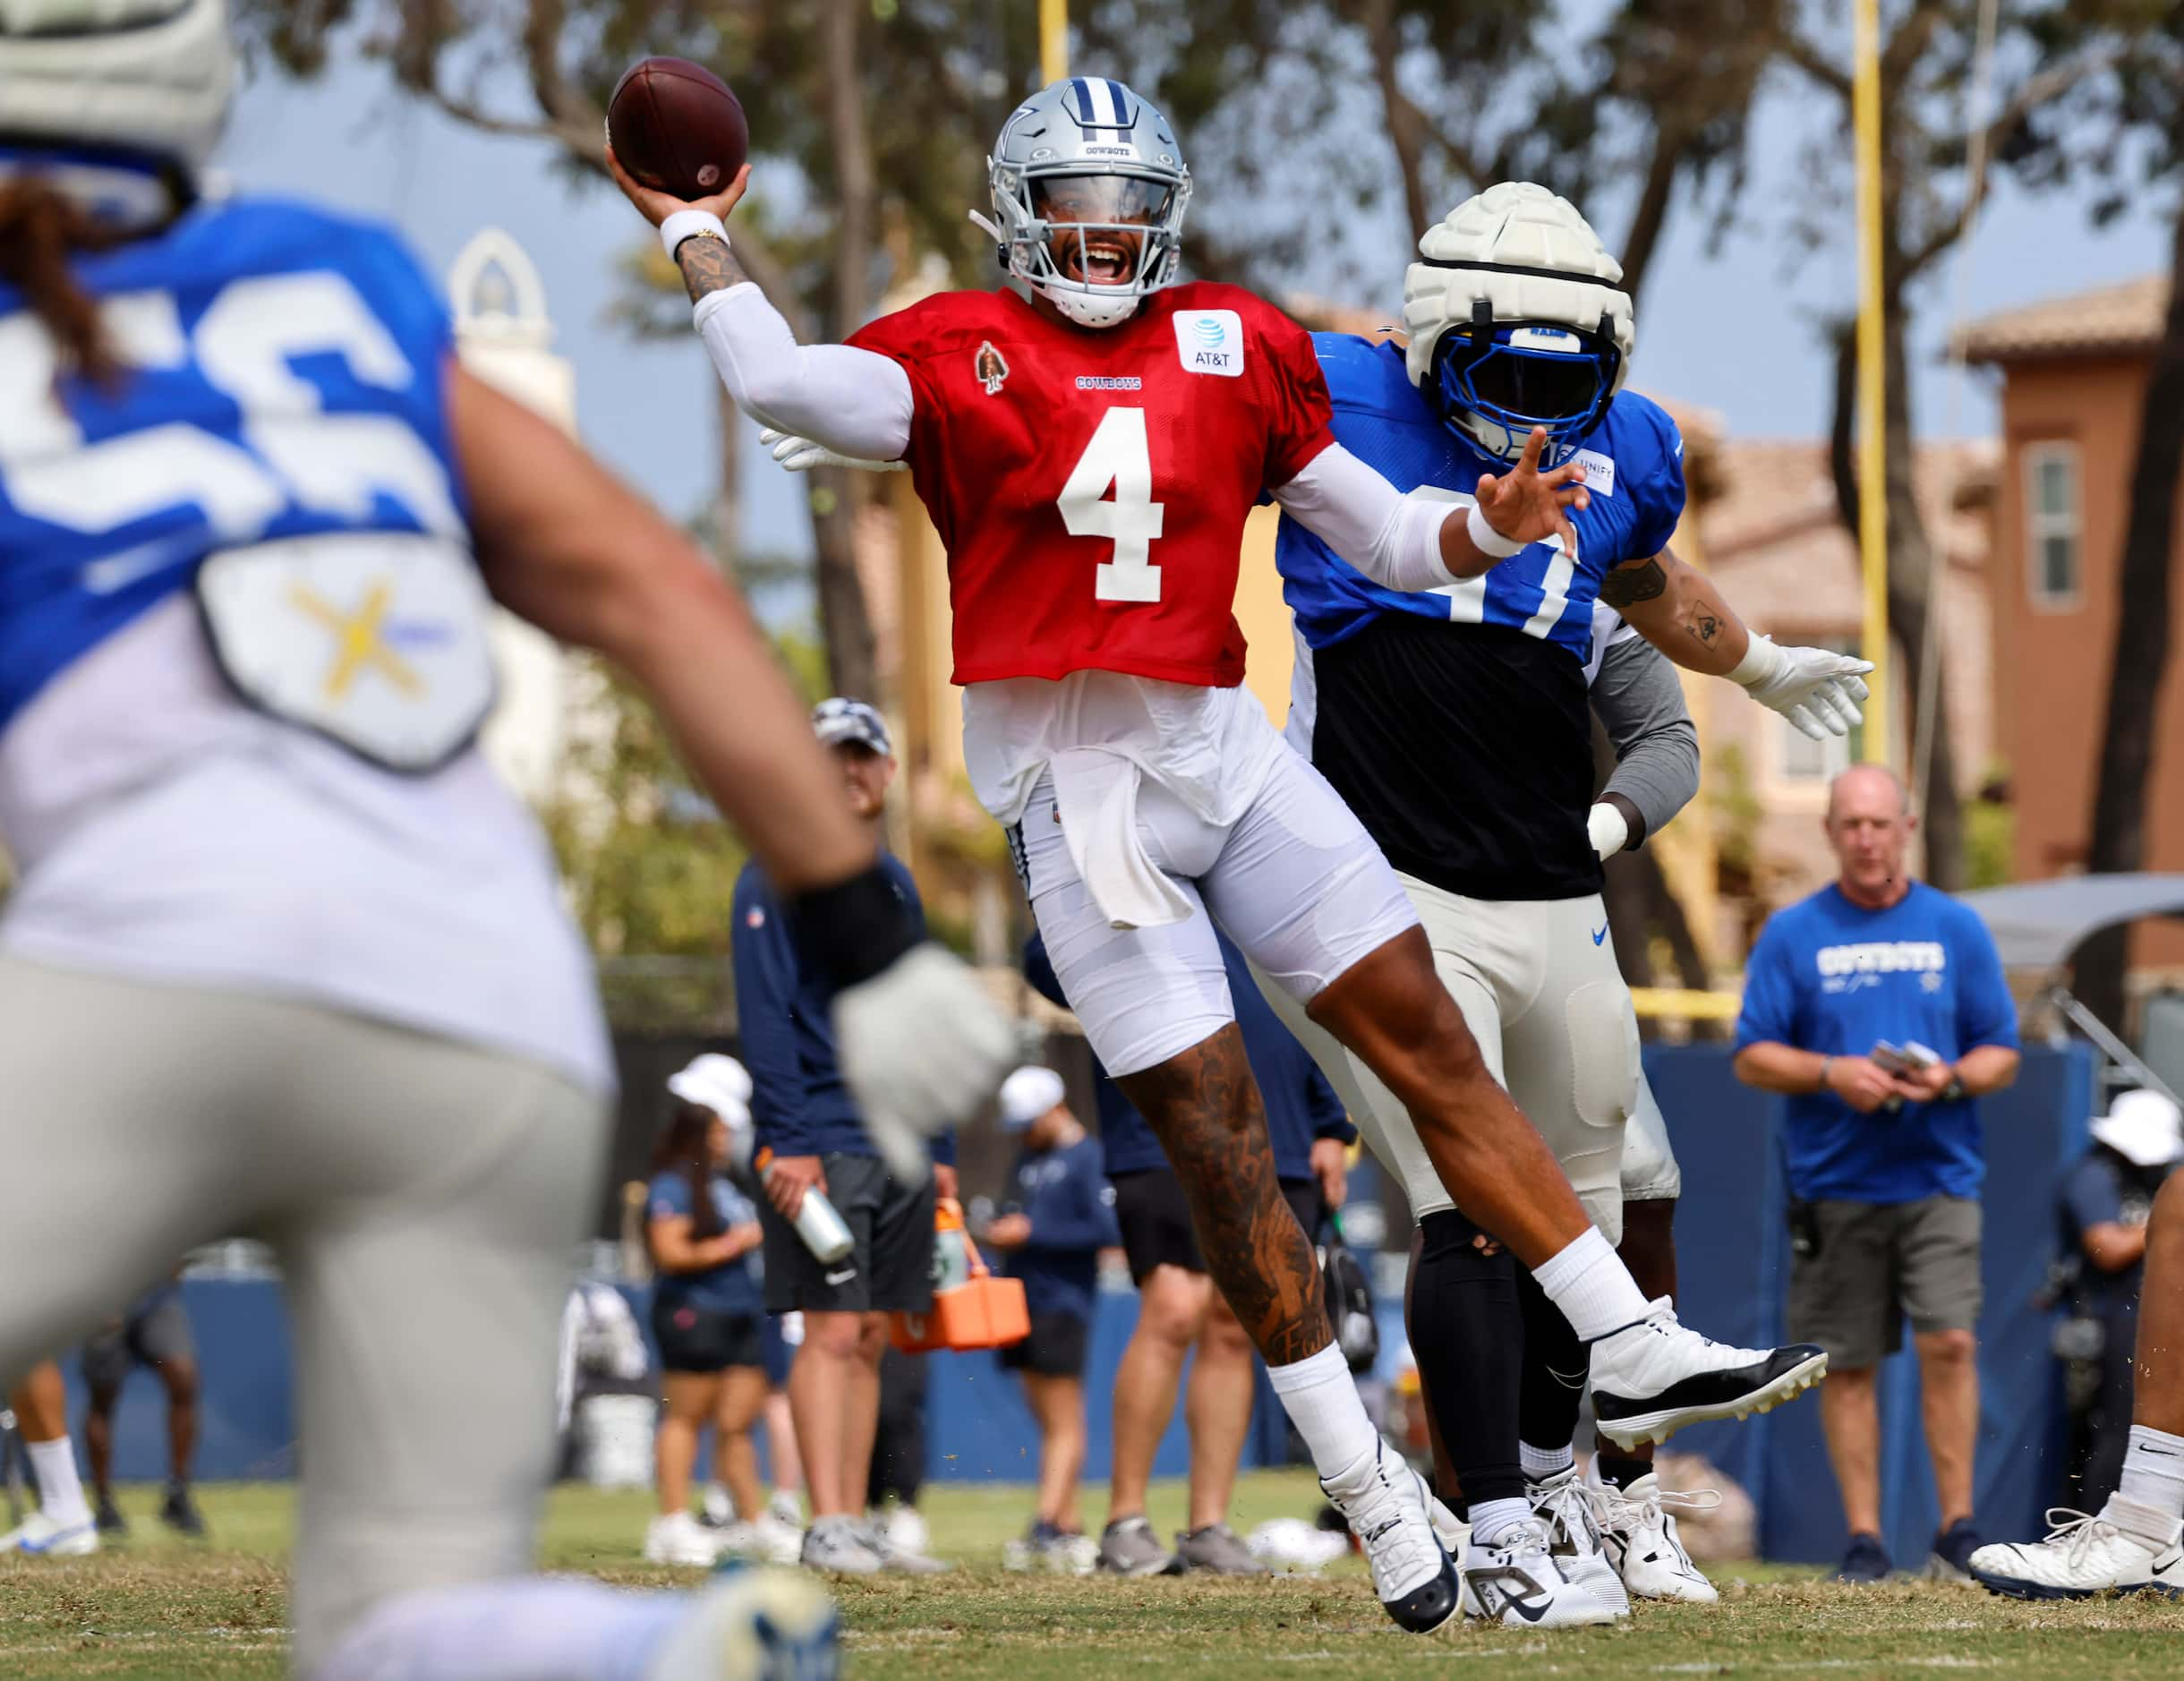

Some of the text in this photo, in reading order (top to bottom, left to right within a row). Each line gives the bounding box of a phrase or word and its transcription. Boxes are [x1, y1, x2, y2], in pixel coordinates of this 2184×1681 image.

[1195, 351, 1231, 368] AT&T
[1076, 376, 1141, 389] COWBOYS
[1056, 406, 1164, 602] 4
